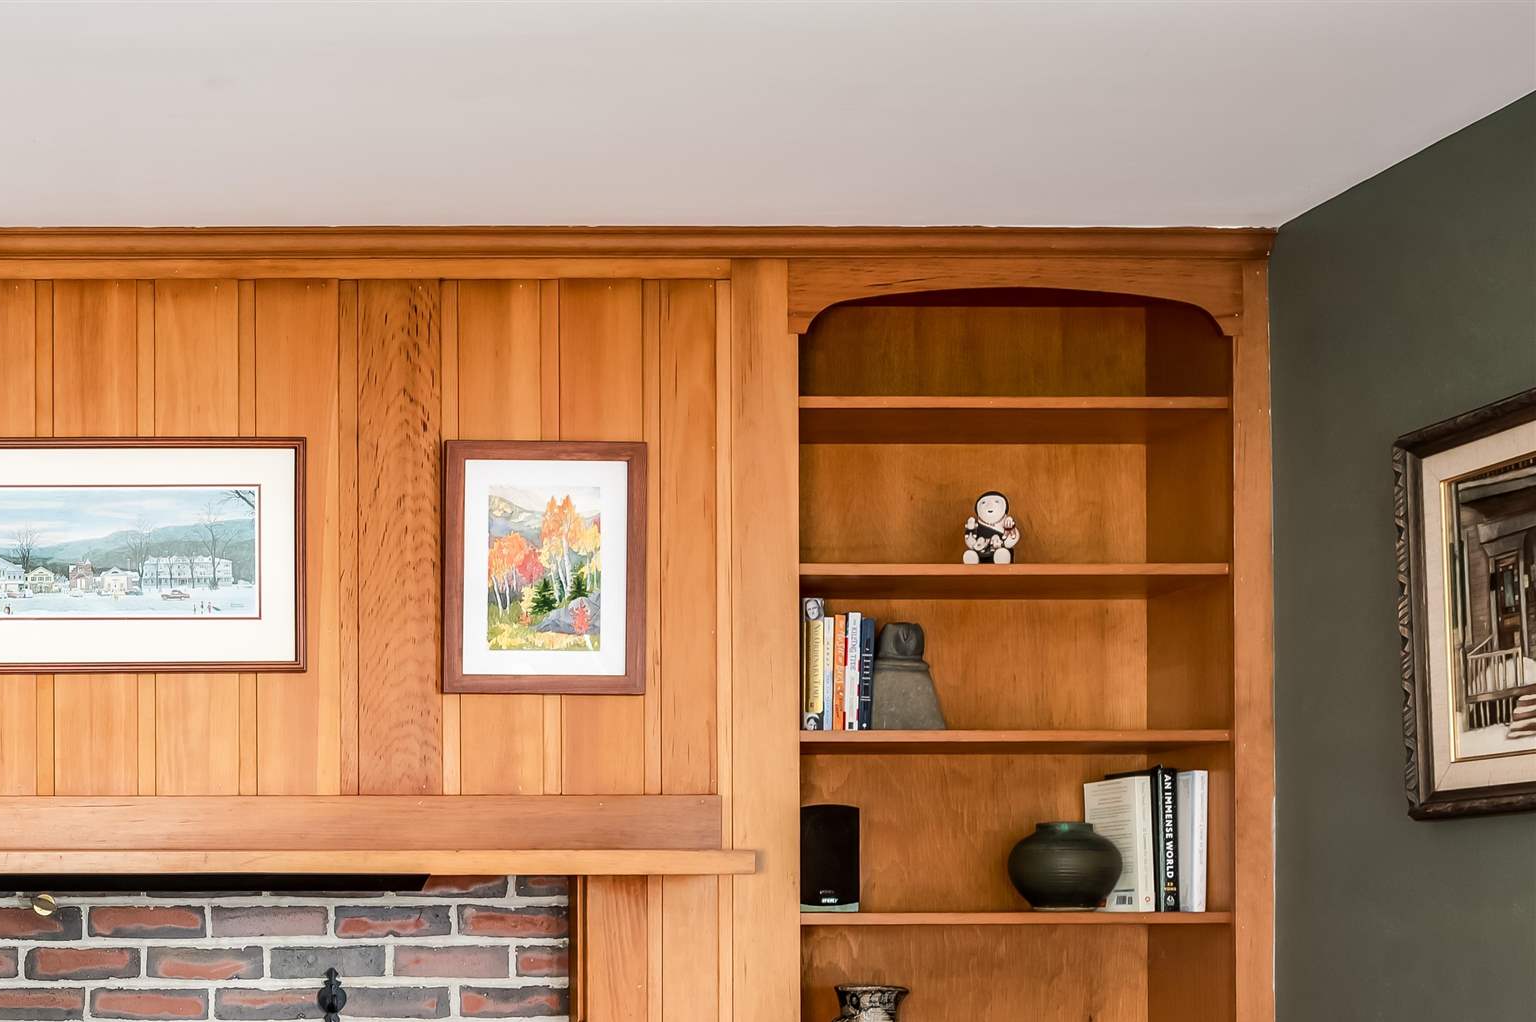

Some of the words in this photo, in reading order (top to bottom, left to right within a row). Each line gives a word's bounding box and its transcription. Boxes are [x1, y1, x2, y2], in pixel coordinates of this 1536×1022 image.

[1164, 774, 1172, 789] AN
[1164, 793, 1174, 838] IMMENSE
[1165, 841, 1174, 879] WORLD
